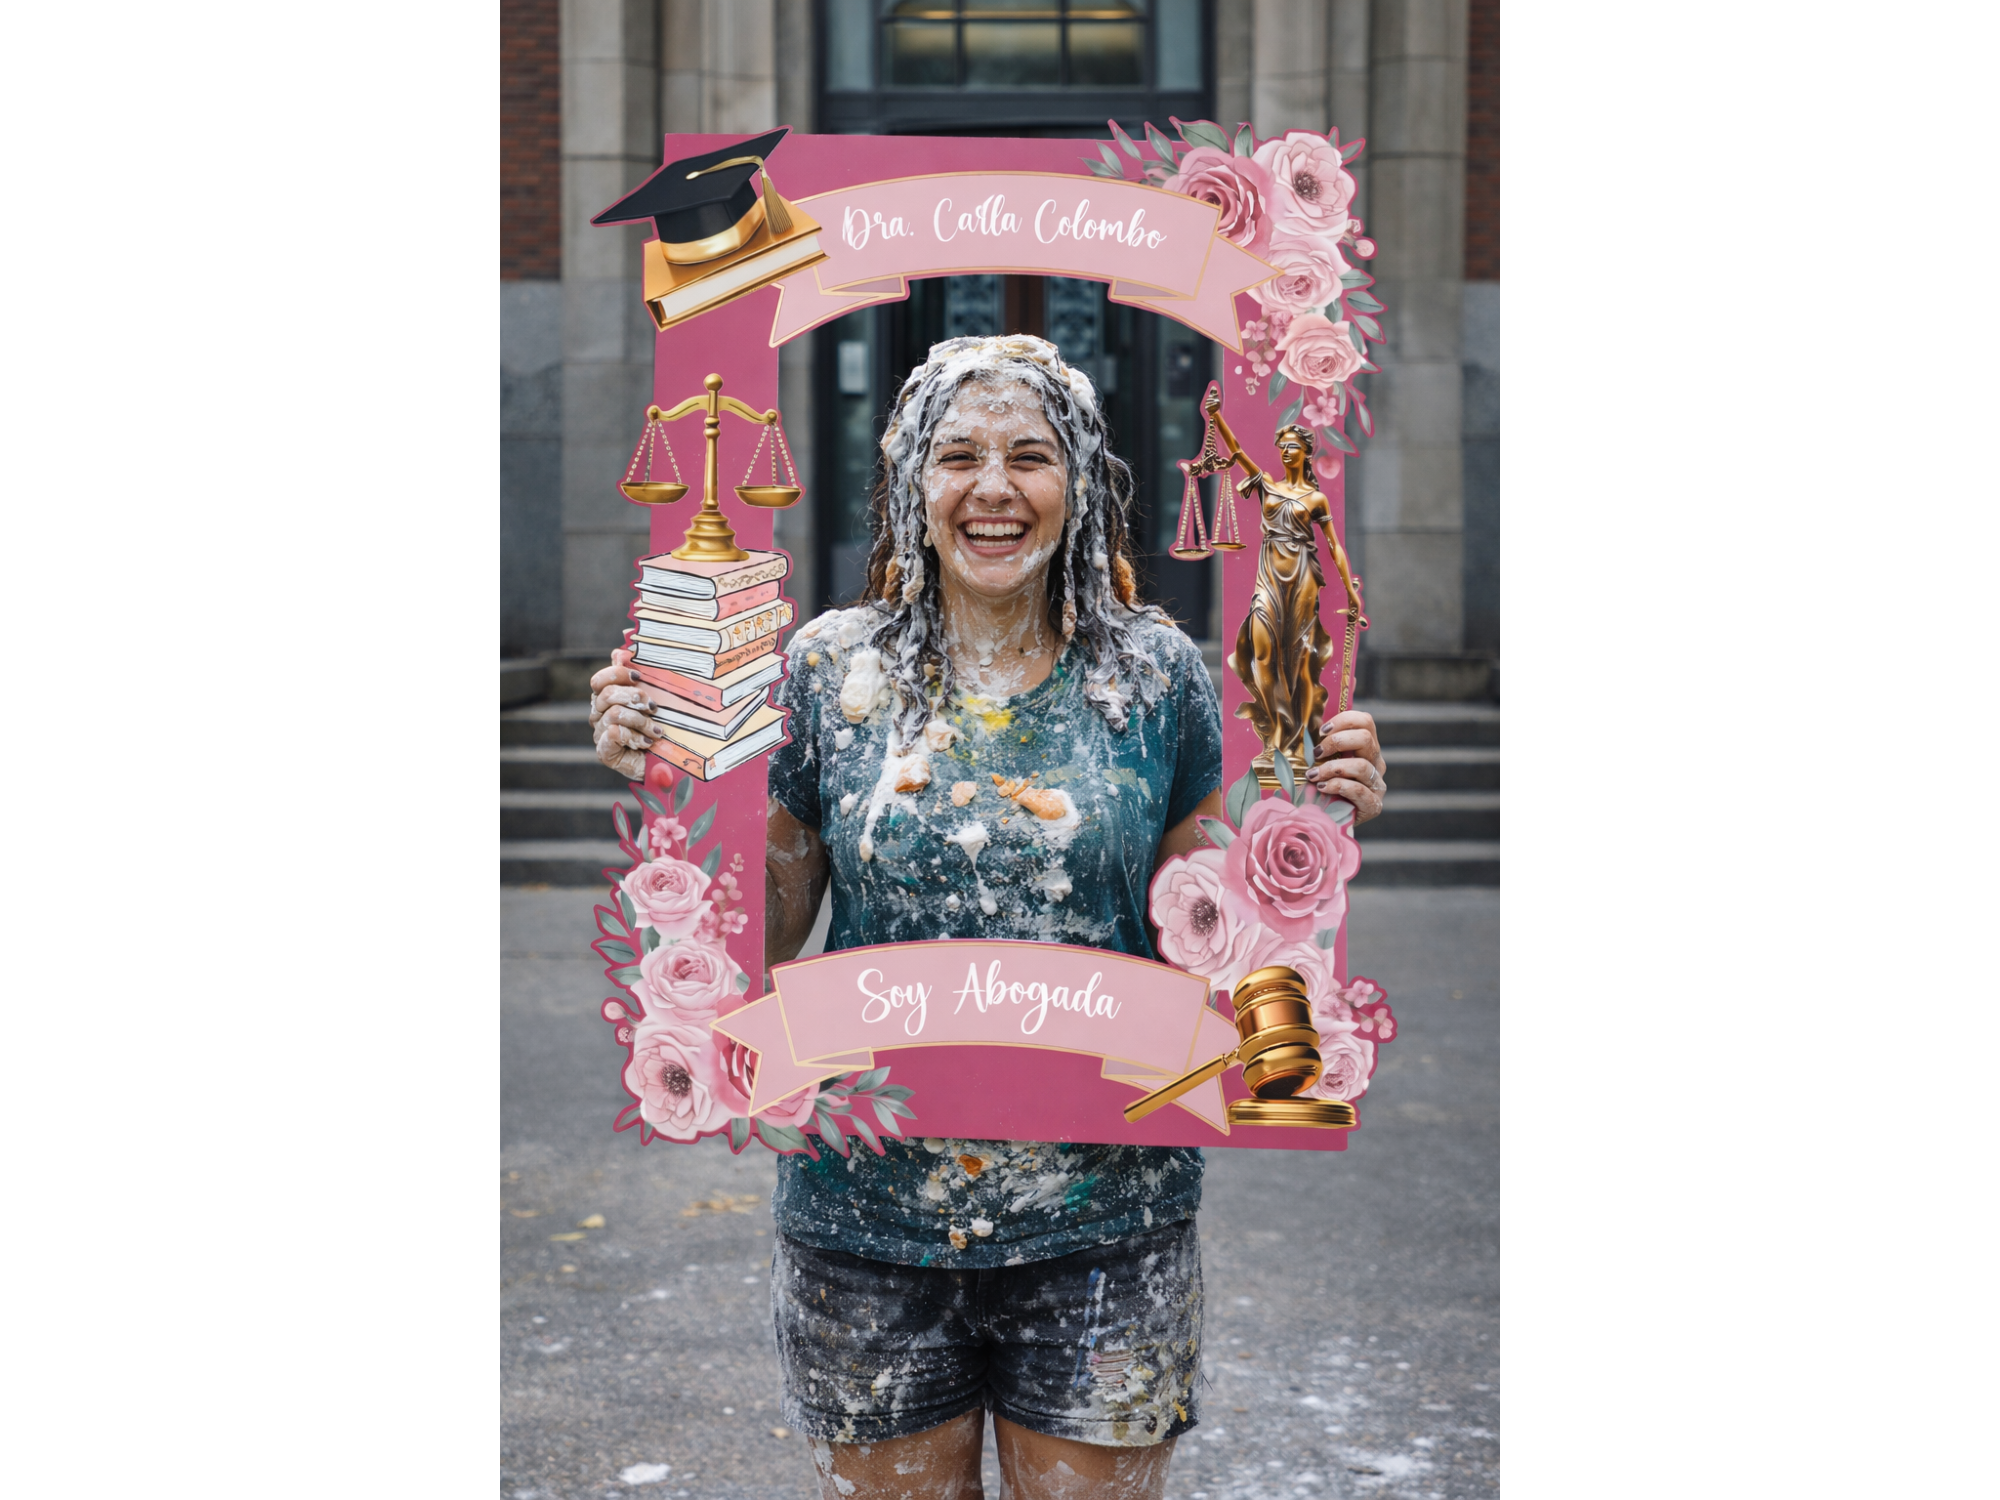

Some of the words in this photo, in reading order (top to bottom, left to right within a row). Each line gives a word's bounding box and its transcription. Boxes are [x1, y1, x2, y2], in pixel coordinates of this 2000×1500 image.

[842, 206, 914, 250] Dra.
[933, 194, 1022, 242] Carla
[1034, 199, 1167, 249] Colombo
[857, 968, 932, 1036] Soy
[953, 960, 1122, 1035] Abogada
